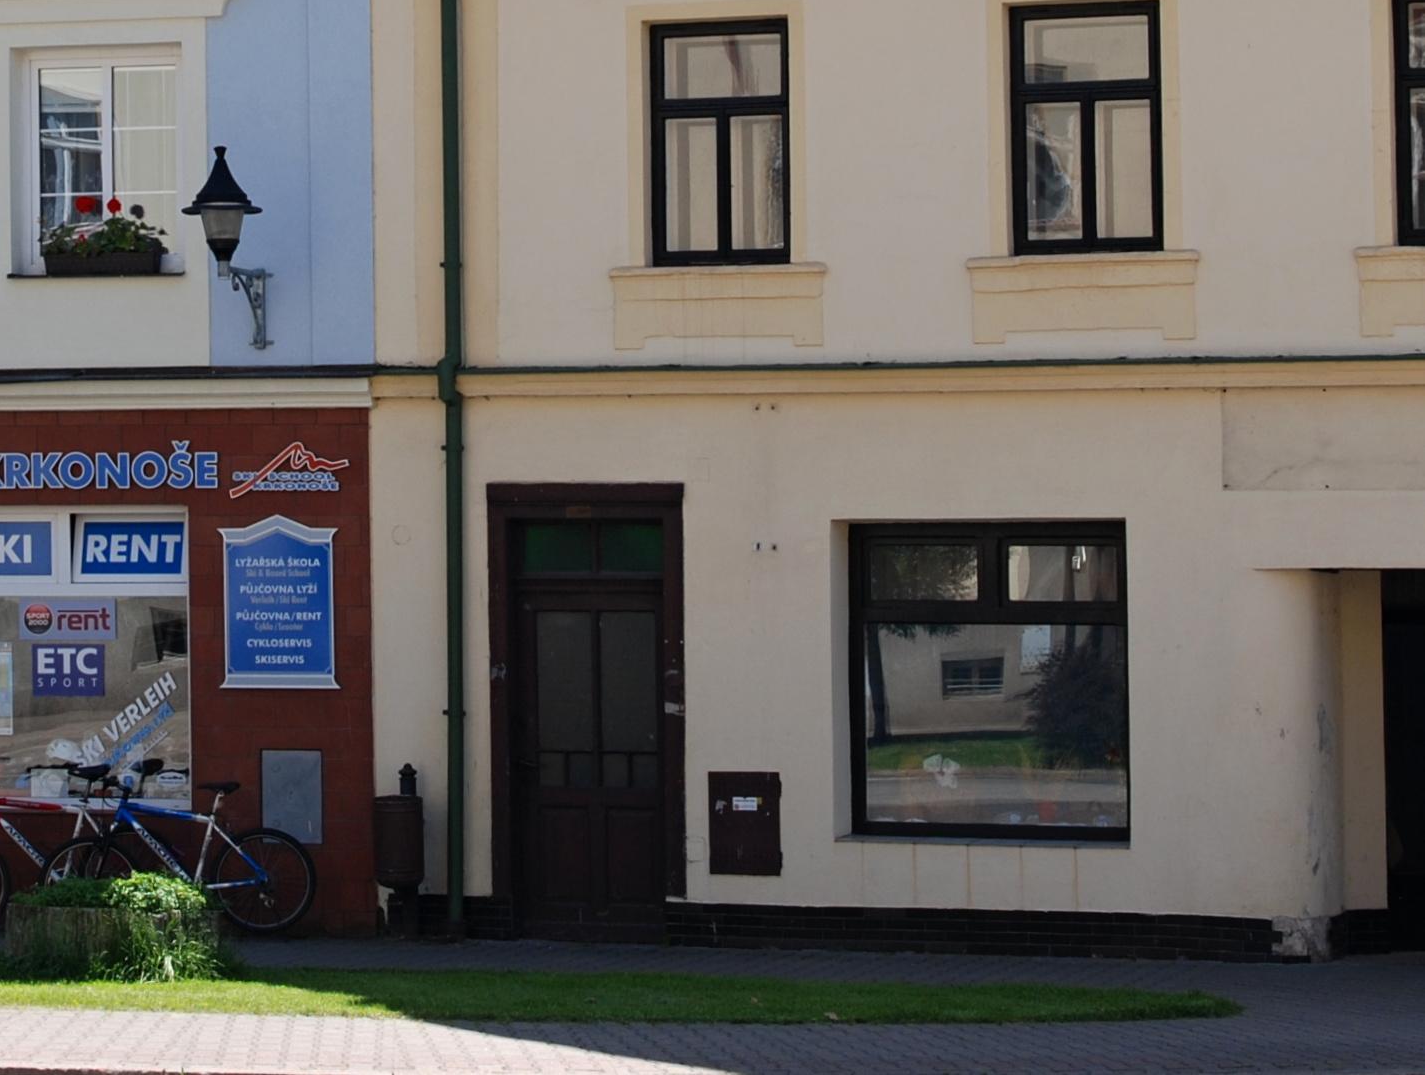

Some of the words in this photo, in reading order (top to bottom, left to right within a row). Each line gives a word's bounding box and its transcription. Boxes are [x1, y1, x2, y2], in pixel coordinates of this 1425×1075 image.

[266, 471, 336, 482] SCHOOL
[85, 534, 181, 563] RENT
[235, 556, 284, 567] LYŽAŘSKÁ
[287, 556, 320, 567] ŠKOLA
[240, 582, 295, 594] PŮJČOVNA
[297, 582, 318, 594] LYŽÍ
[26, 612, 50, 620] SPORT
[57, 608, 111, 631] rent
[246, 638, 312, 648] CYKLOSERVIS
[36, 647, 98, 674] ETC
[255, 655, 305, 665] SKISERVIS
[36, 678, 98, 688] SPORT
[76, 735, 106, 768] SKI
[103, 672, 177, 742] VERLEIH
